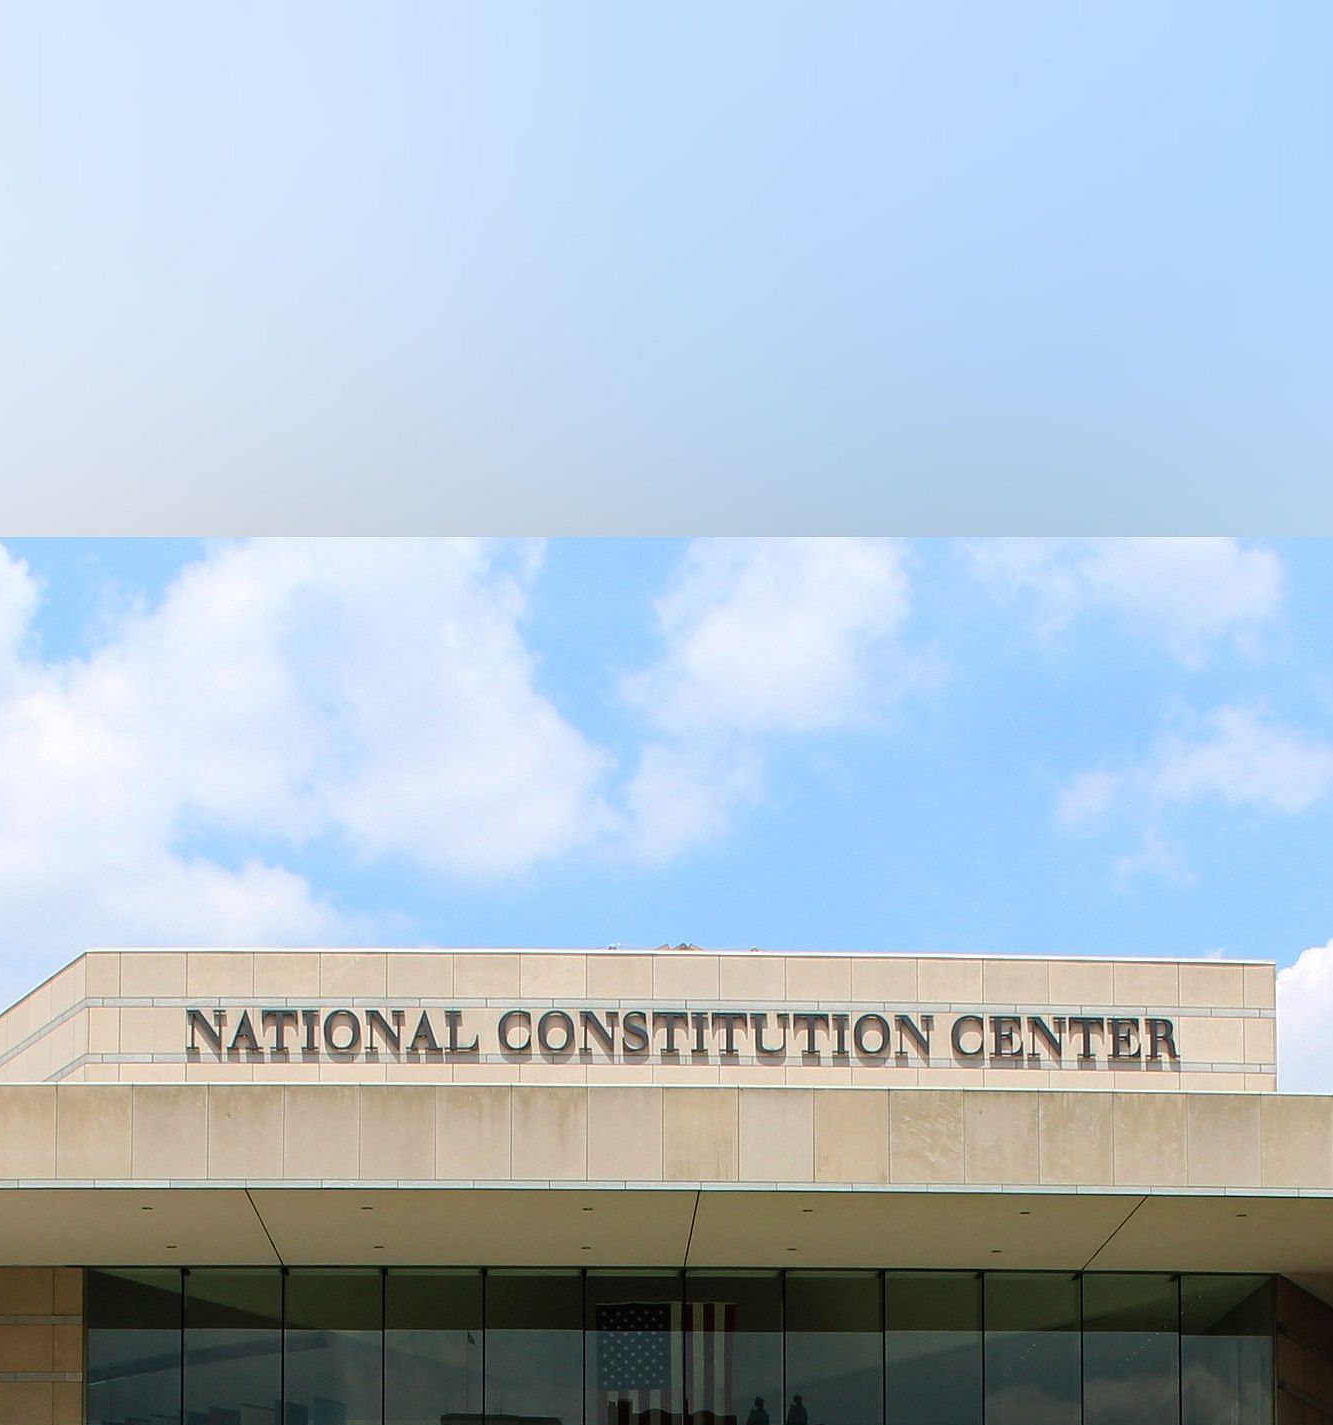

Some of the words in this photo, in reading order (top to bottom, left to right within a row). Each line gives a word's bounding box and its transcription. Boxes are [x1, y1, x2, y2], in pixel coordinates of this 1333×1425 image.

[186, 1009, 480, 1051] NATIONAL
[498, 1010, 934, 1056] CONSTITUTION
[950, 1014, 1181, 1059] CENTER
